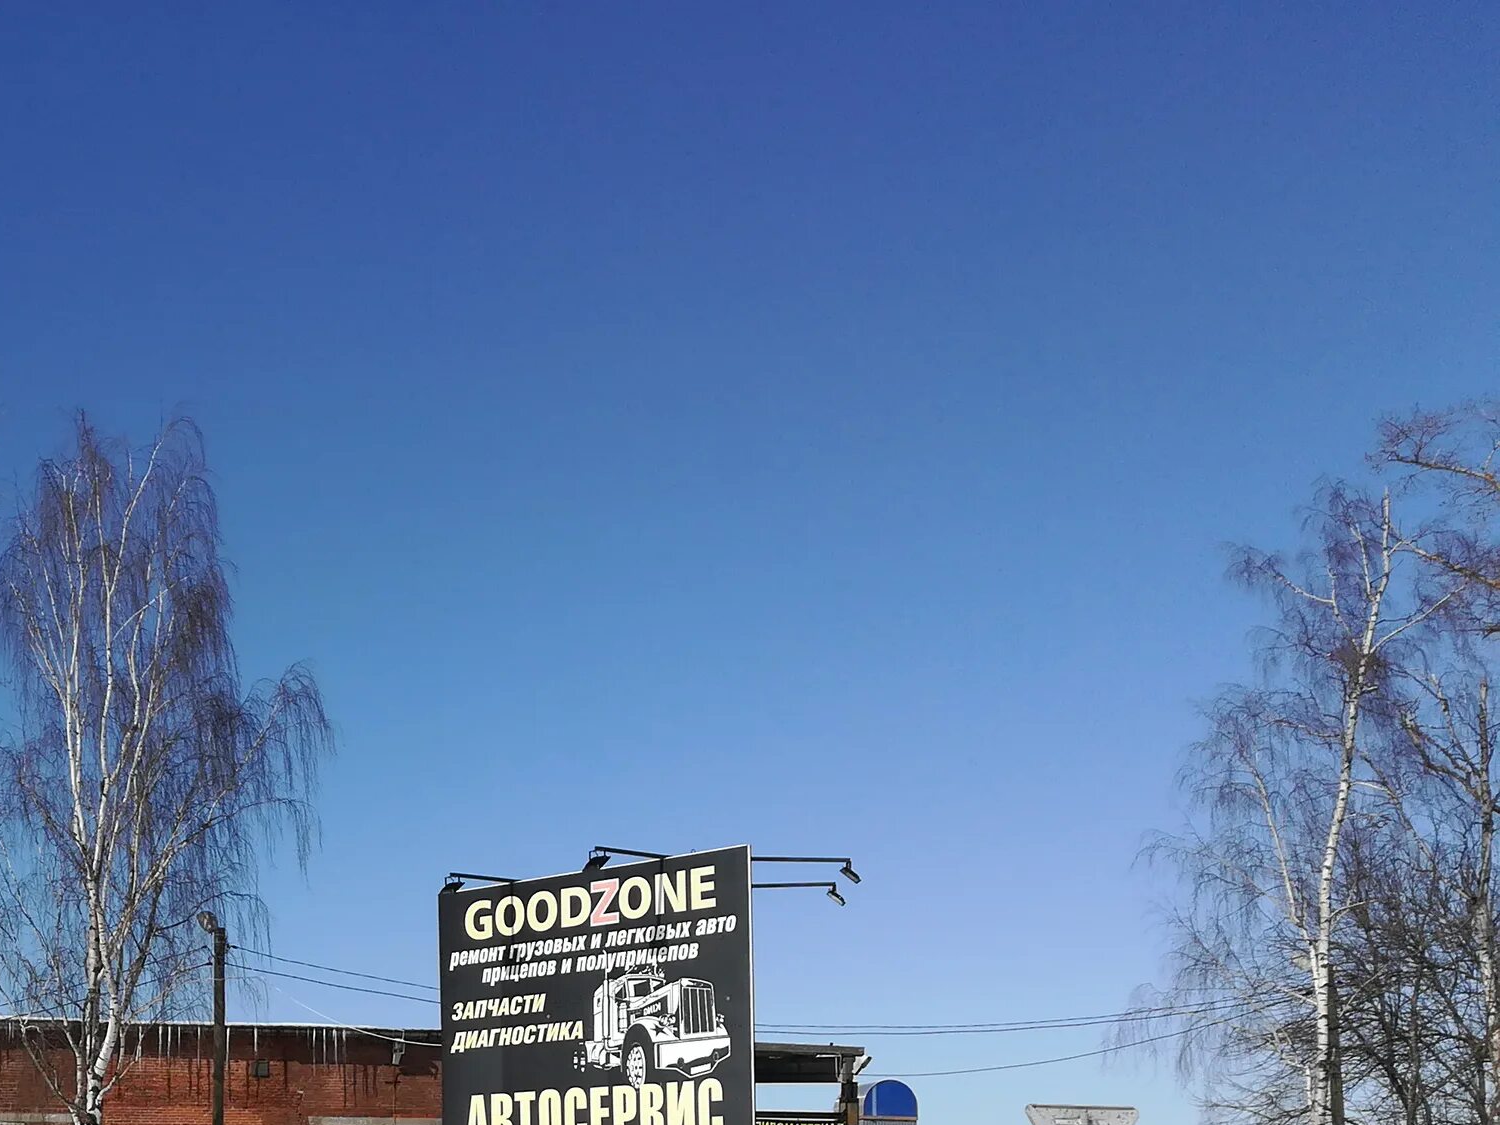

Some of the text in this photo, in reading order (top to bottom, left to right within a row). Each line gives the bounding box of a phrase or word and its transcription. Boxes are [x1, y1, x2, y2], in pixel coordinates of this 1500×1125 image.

[464, 866, 716, 941] GOODZONE
[450, 916, 736, 971] ремонт грузовых и легковых авто
[482, 945, 698, 986] прицепов и полуприцепов
[452, 994, 546, 1021] ЗАПЧАСТИ
[451, 1021, 583, 1053] ДИАГНОСТИКА
